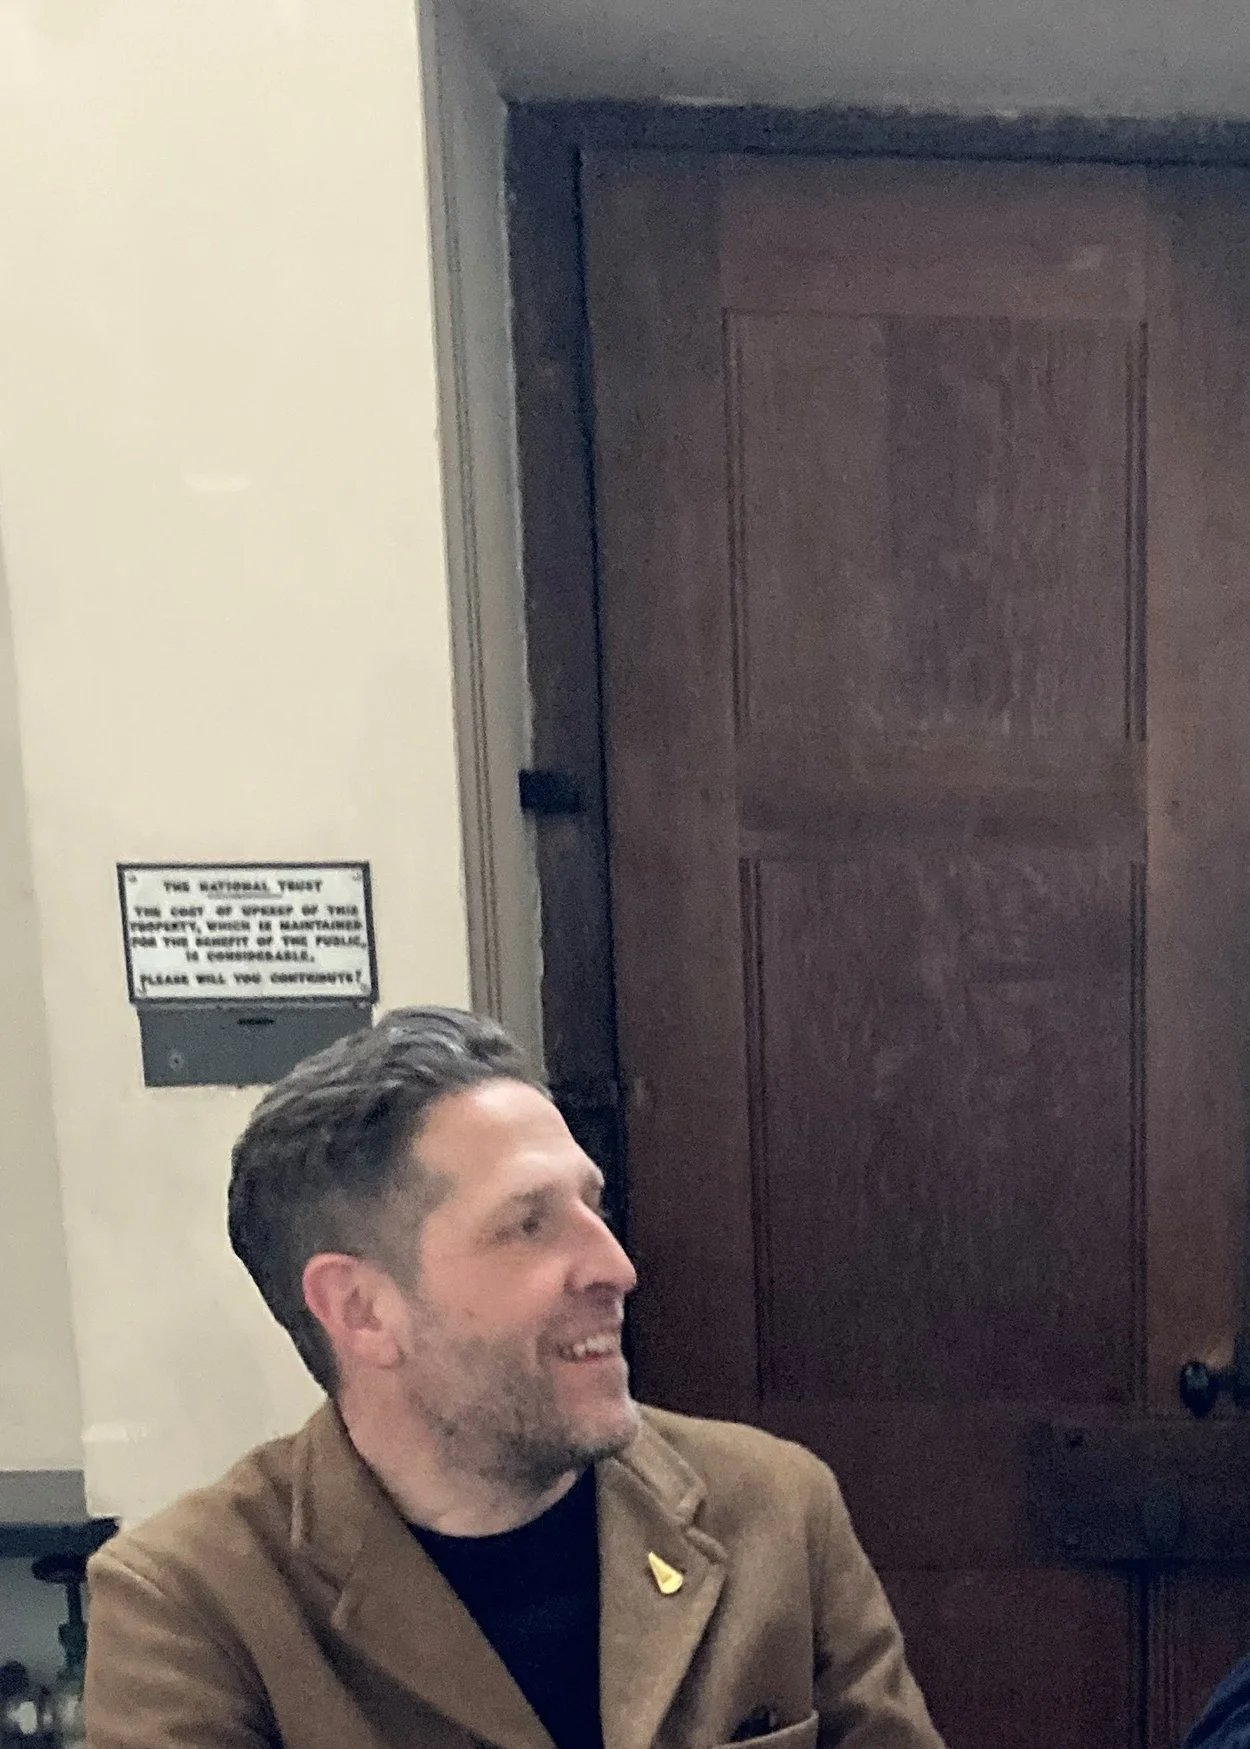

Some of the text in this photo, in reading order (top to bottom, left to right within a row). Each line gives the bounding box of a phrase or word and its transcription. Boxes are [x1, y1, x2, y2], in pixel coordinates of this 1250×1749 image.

[163, 879, 322, 892] THE NATIONAL TRUST
[134, 907, 160, 917] THE
[170, 906, 202, 916] COST
[216, 906, 232, 916] OF
[302, 905, 318, 915] OF
[327, 904, 358, 915] THIS
[206, 921, 250, 931] WHICH
[259, 920, 271, 931] IS
[280, 919, 362, 930] MAINTAINED
[132, 937, 156, 947] FOR
[163, 937, 188, 947] THE
[196, 936, 248, 947] BENEFIT
[257, 936, 273, 946] OF
[282, 935, 307, 946] THE
[186, 951, 199, 961] IS
[140, 974, 189, 985] PLEASE
[196, 973, 225, 984] WILL
[233, 973, 261, 984] YOU
